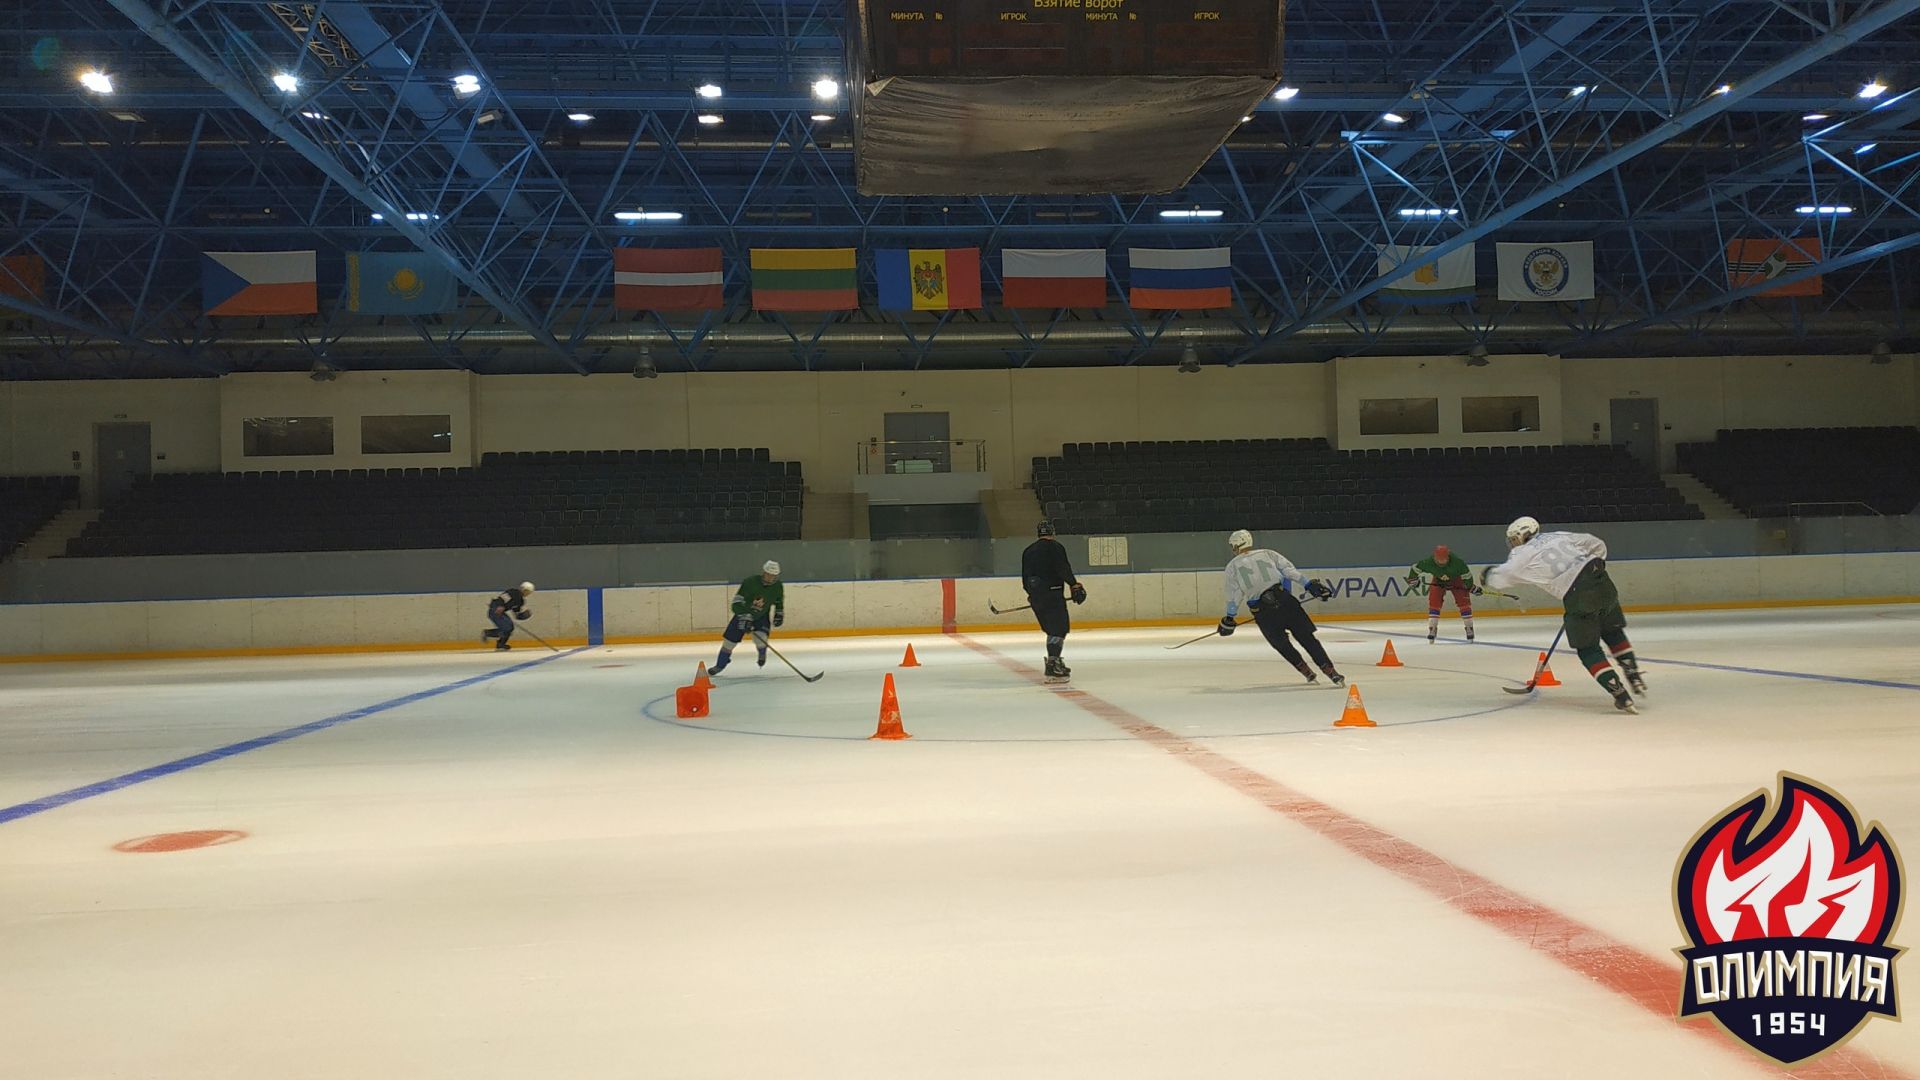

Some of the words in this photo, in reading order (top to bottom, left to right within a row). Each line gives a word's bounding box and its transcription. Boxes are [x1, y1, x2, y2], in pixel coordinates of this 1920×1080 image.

[1085, 0, 1123, 10] ворот
[890, 12, 925, 21] МИНУТА
[935, 12, 943, 20] №
[1000, 12, 1027, 21] ИГРОК
[1085, 12, 1118, 21] МИНУТА
[1129, 12, 1137, 20] №
[1194, 12, 1220, 20] ИГРОК
